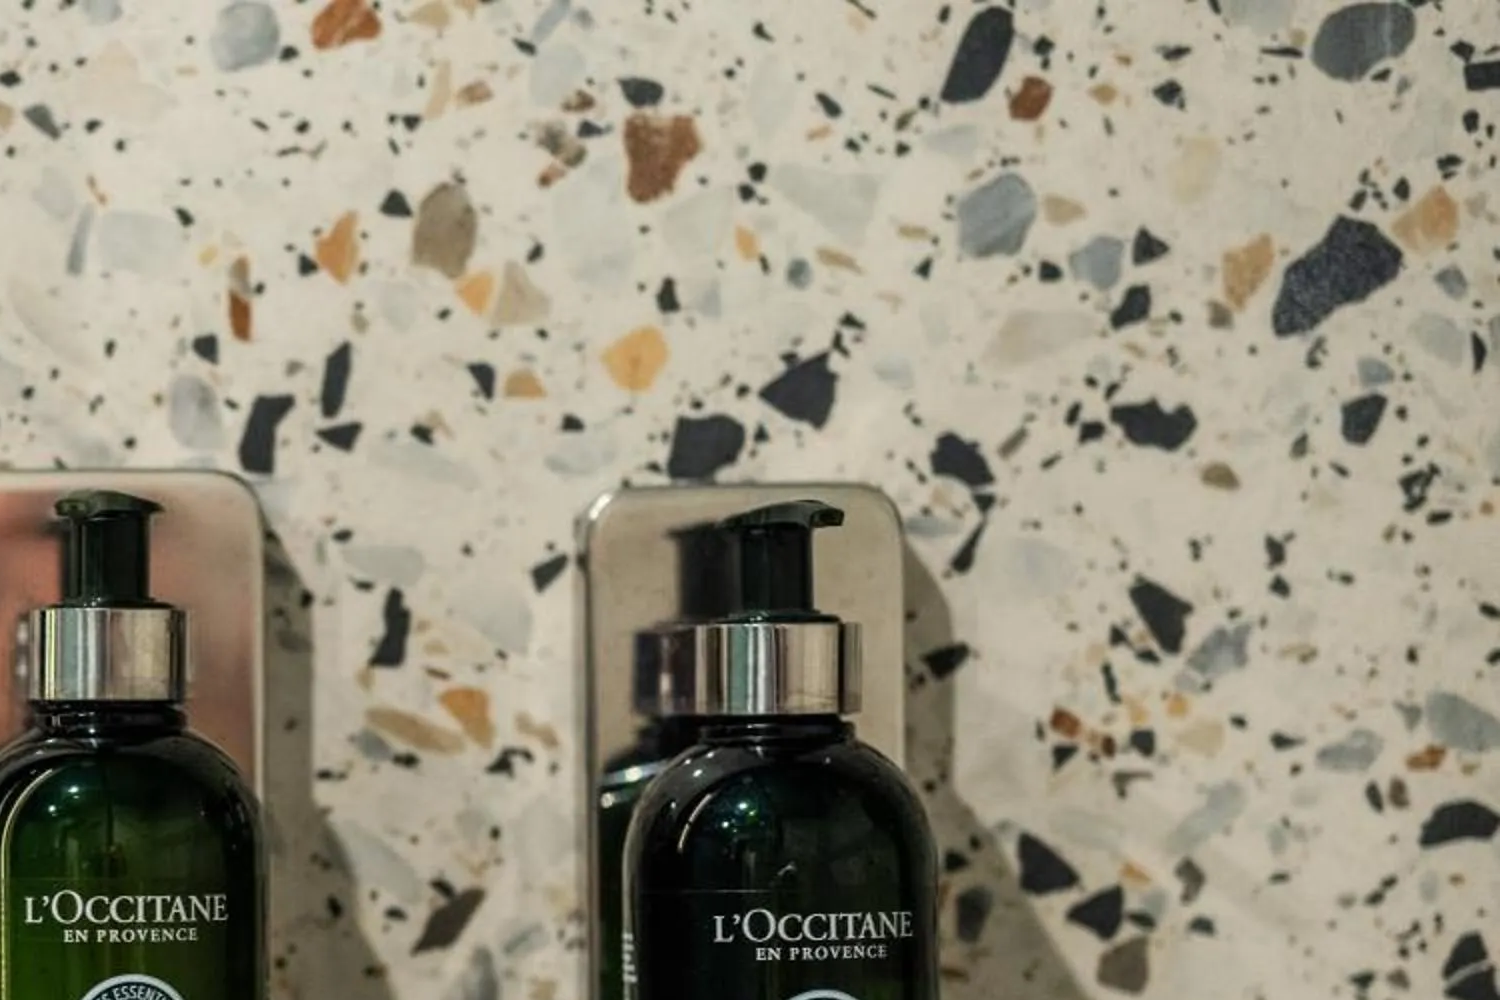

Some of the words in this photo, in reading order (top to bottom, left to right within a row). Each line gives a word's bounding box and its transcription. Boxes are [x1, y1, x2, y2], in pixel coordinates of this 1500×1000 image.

[24, 889, 229, 924] L'OCCITANE
[63, 929, 89, 943] EN
[97, 927, 199, 943] PROVENCE
[713, 908, 914, 943] L'OCCITANE
[755, 947, 781, 961] EN
[789, 944, 888, 961] PROVENCE
